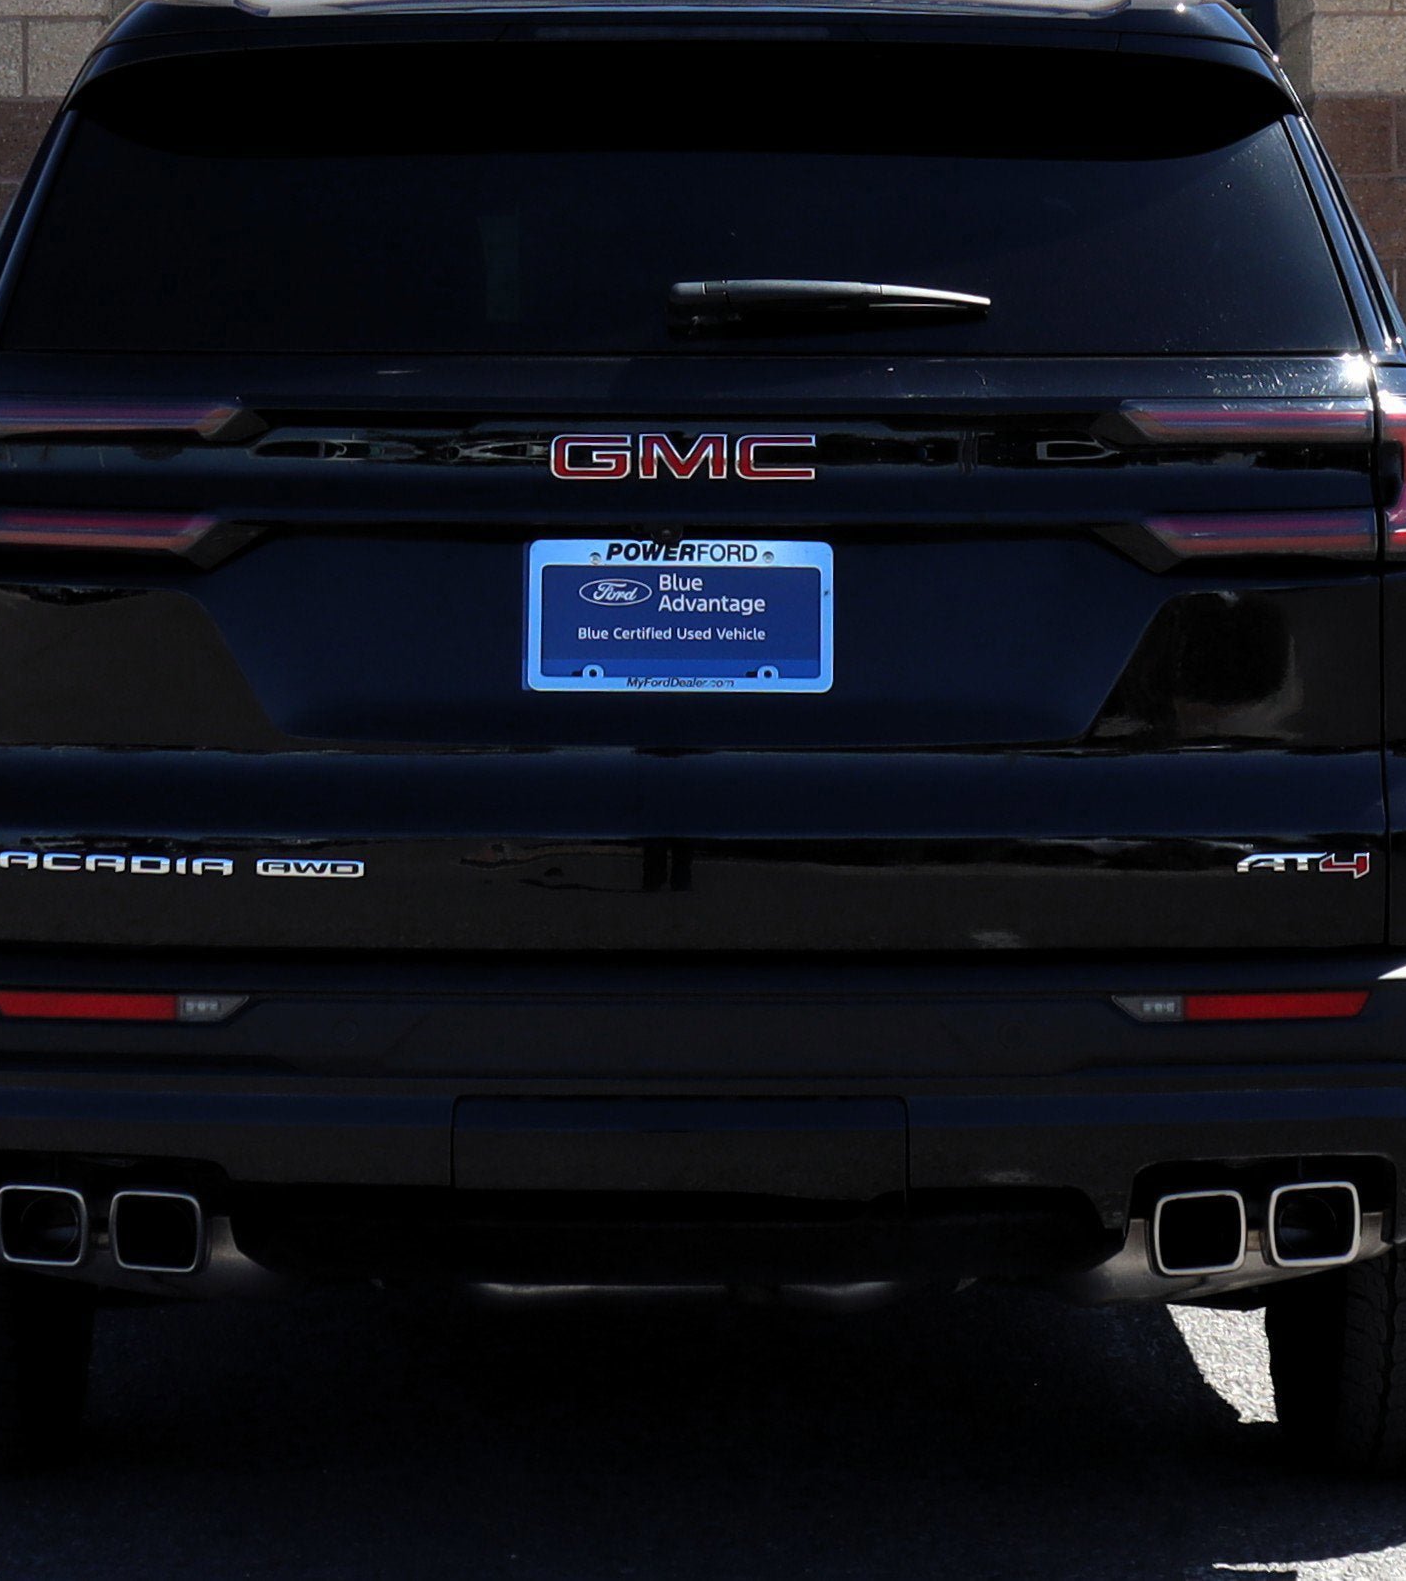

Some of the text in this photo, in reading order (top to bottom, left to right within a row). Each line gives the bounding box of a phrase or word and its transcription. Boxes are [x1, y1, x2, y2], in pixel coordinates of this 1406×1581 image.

[550, 434, 815, 480] GMC
[593, 582, 639, 602] Ford
[659, 574, 703, 592] Blue
[658, 595, 766, 616] Advantage
[578, 627, 766, 641] Blue Certified Used Vehicle
[0, 850, 360, 876] ACADIA AWD
[1236, 852, 1370, 880] AT4
